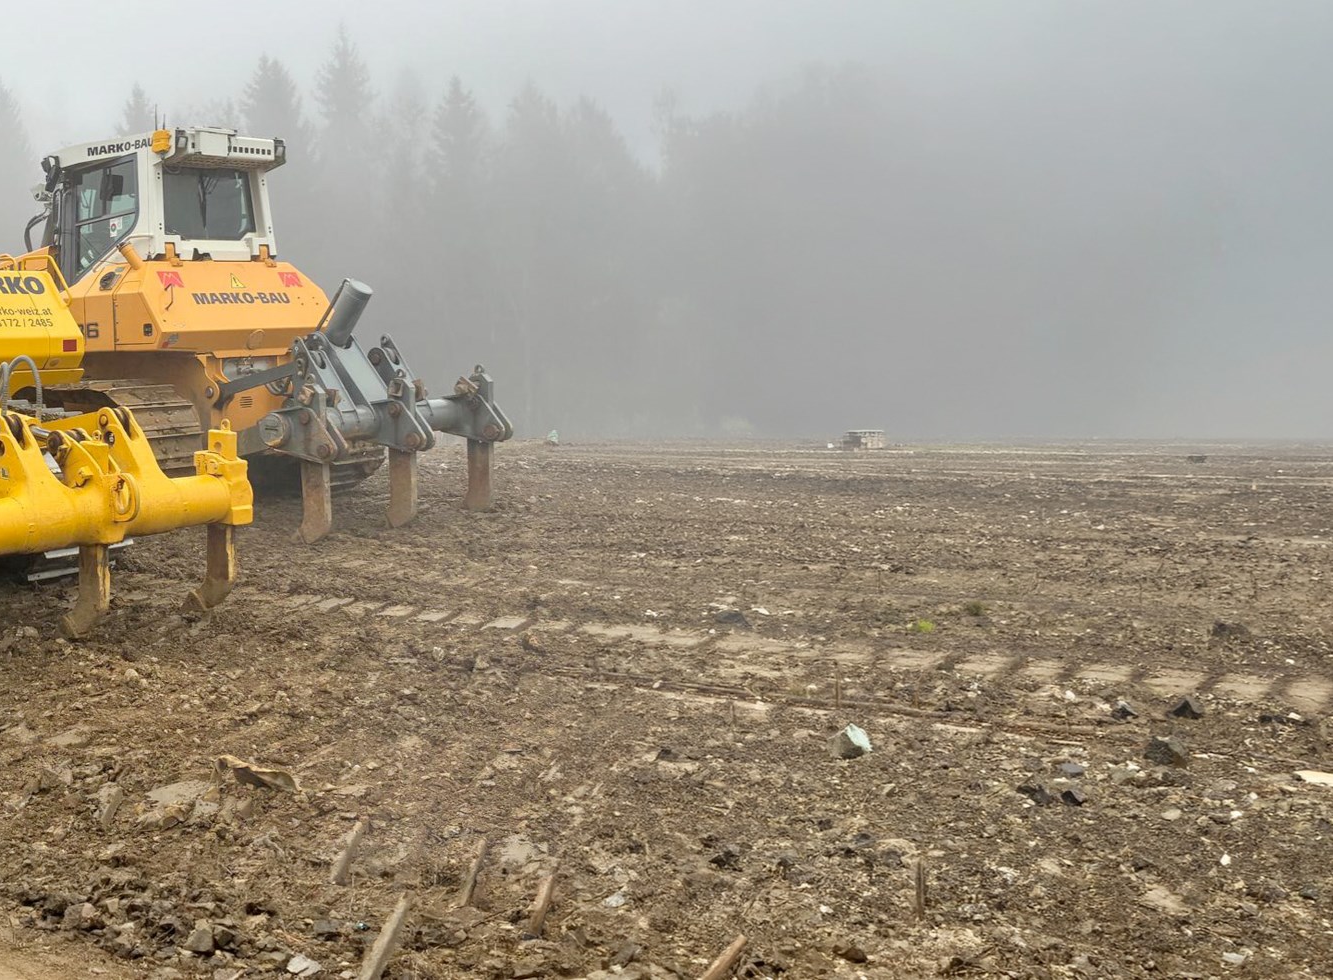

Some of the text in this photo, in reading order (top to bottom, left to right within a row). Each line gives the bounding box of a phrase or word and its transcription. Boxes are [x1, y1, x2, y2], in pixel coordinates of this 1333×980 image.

[87, 138, 153, 156] MARKO-BAU
[192, 292, 290, 304] MARKO-BAU
[30, 318, 53, 327] 2485
